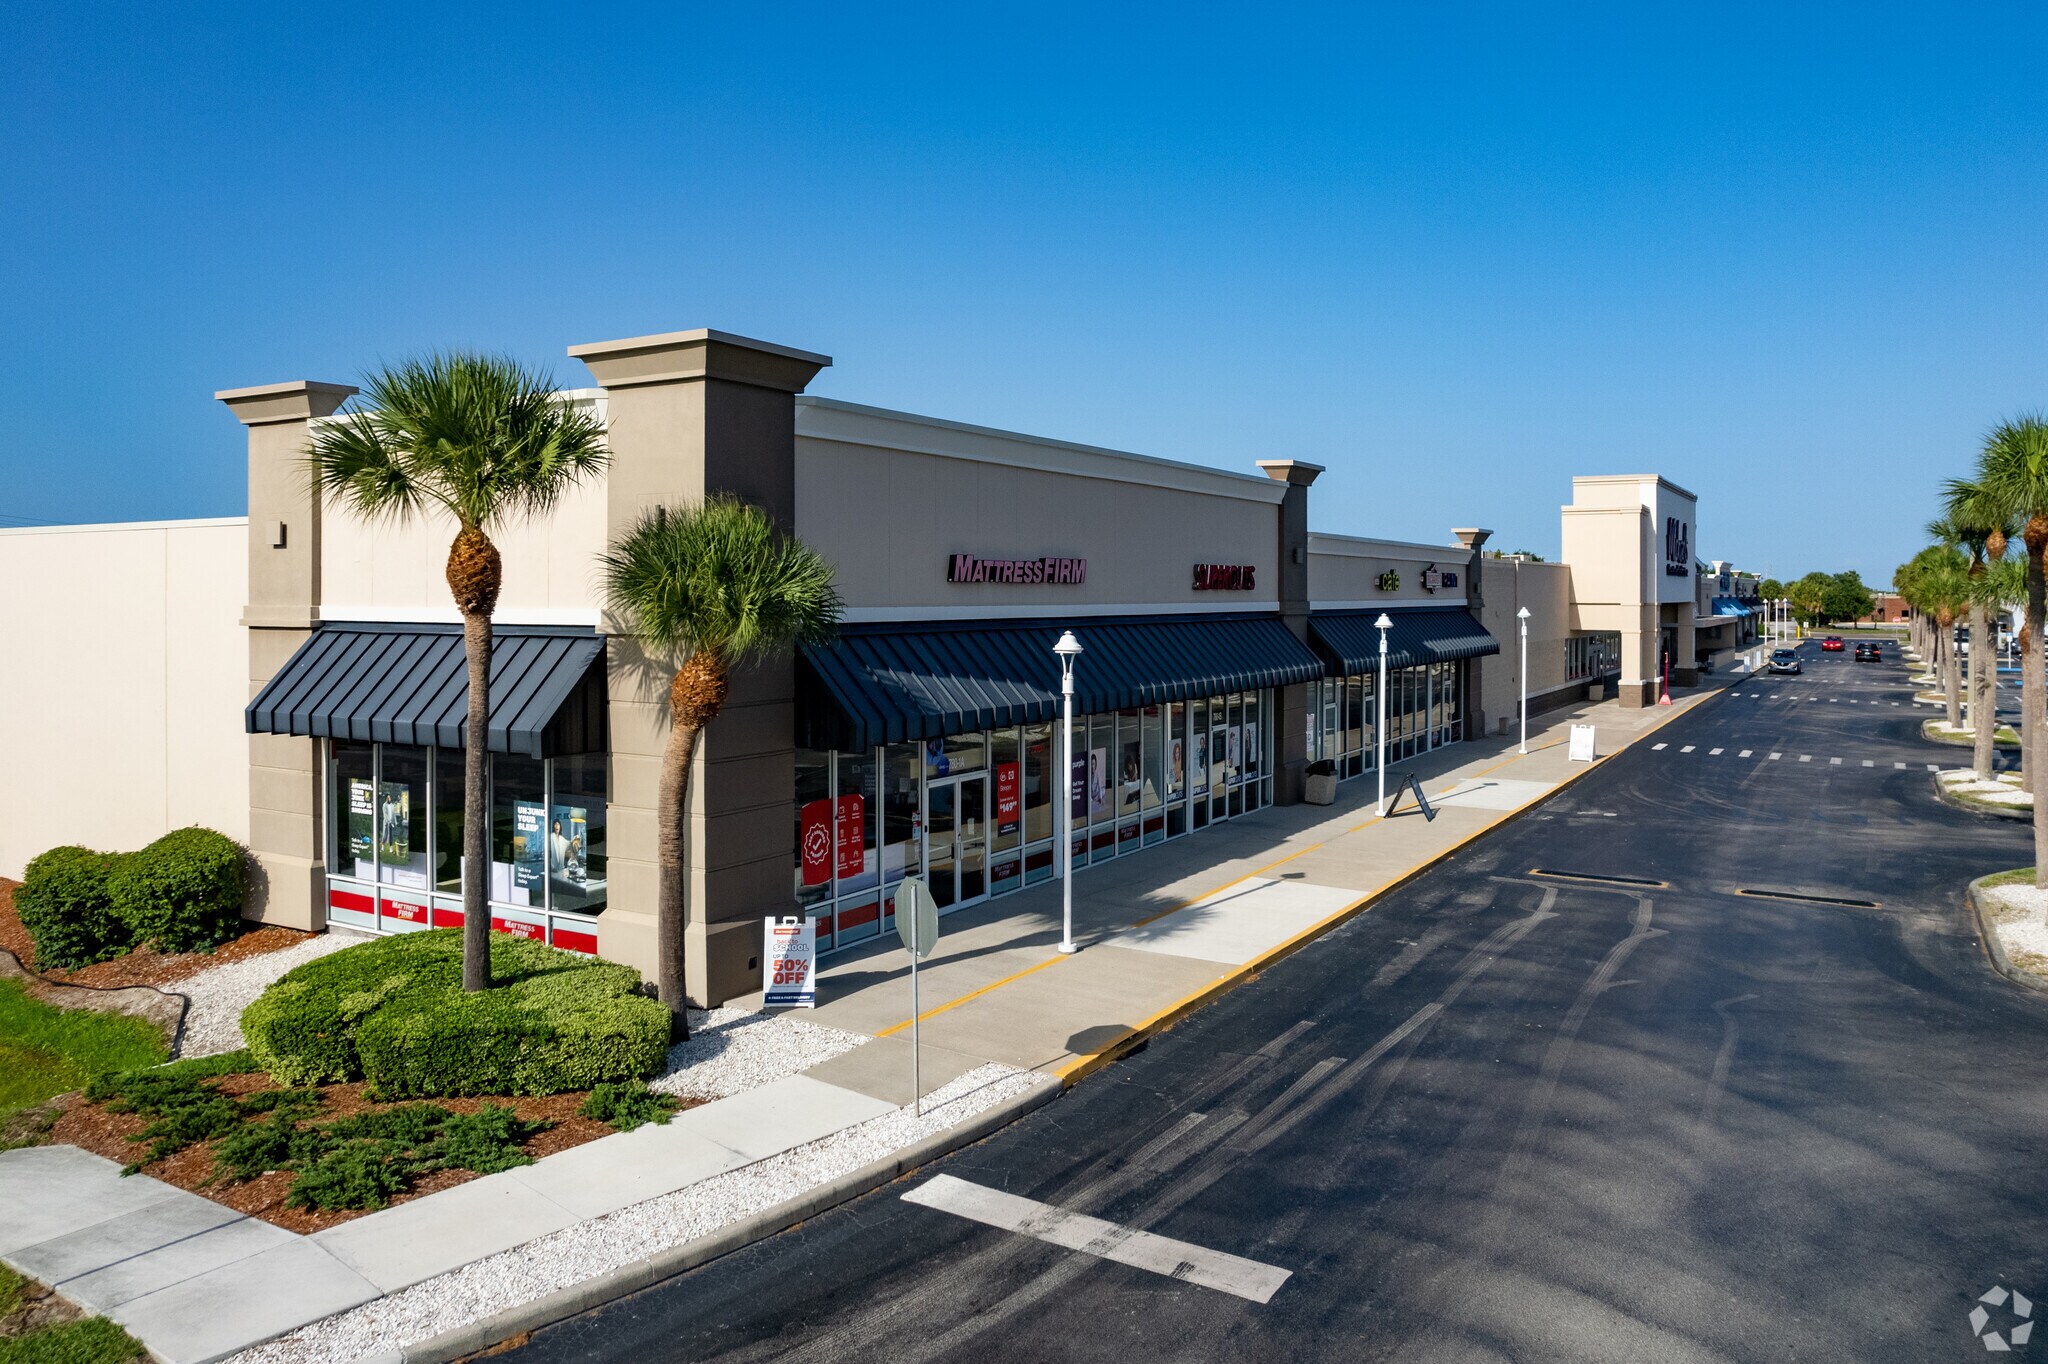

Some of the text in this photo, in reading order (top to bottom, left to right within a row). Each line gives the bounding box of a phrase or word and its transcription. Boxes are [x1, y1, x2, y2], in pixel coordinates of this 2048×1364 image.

[518, 815, 536, 824] YOUR
[518, 823, 539, 832] SLEEP
[392, 901, 419, 912] MATTRESS
[398, 910, 413, 919] FIRM
[504, 920, 535, 932] MATTRESS
[511, 930, 528, 938] FIRM
[773, 944, 809, 952] SCHOOL
[773, 959, 809, 971] 50%
[773, 972, 805, 984] OFF
